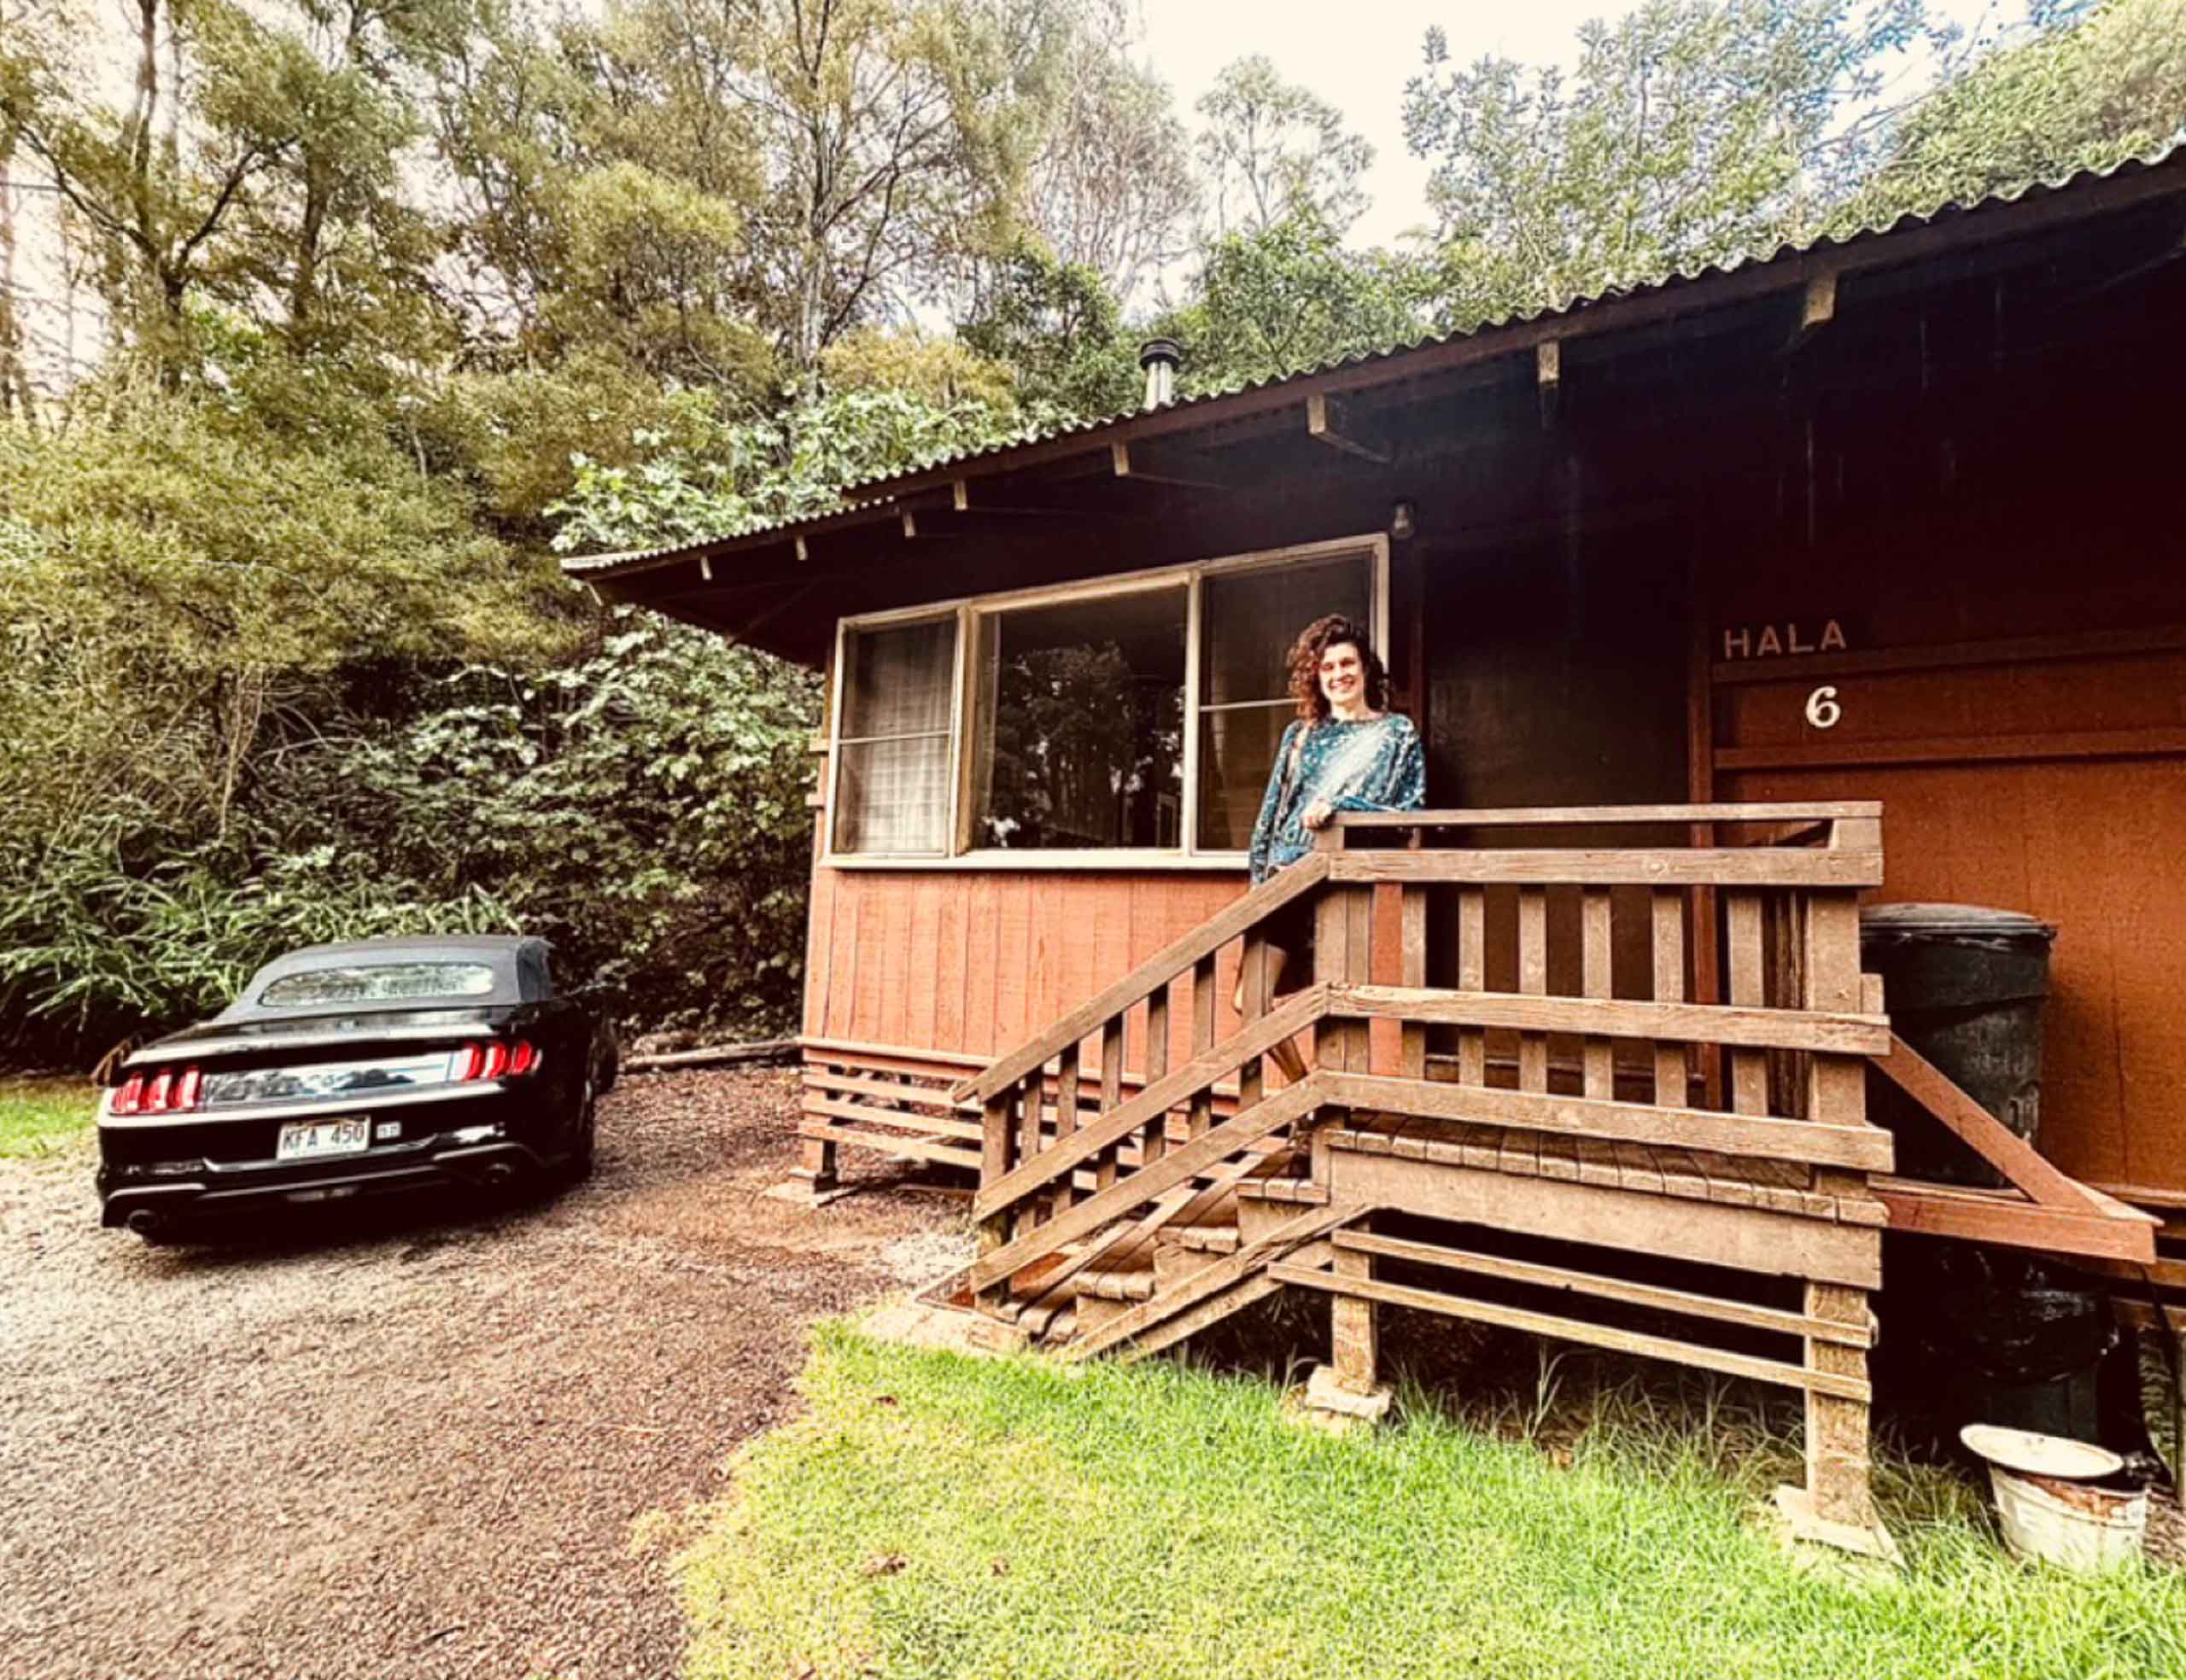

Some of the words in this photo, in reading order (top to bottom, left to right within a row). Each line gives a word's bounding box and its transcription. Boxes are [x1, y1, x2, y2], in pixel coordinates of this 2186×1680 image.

[1724, 619, 1847, 659] HALA
[1805, 685, 1841, 728] 6
[283, 1127, 319, 1151] KFA
[330, 1121, 365, 1145] 450
